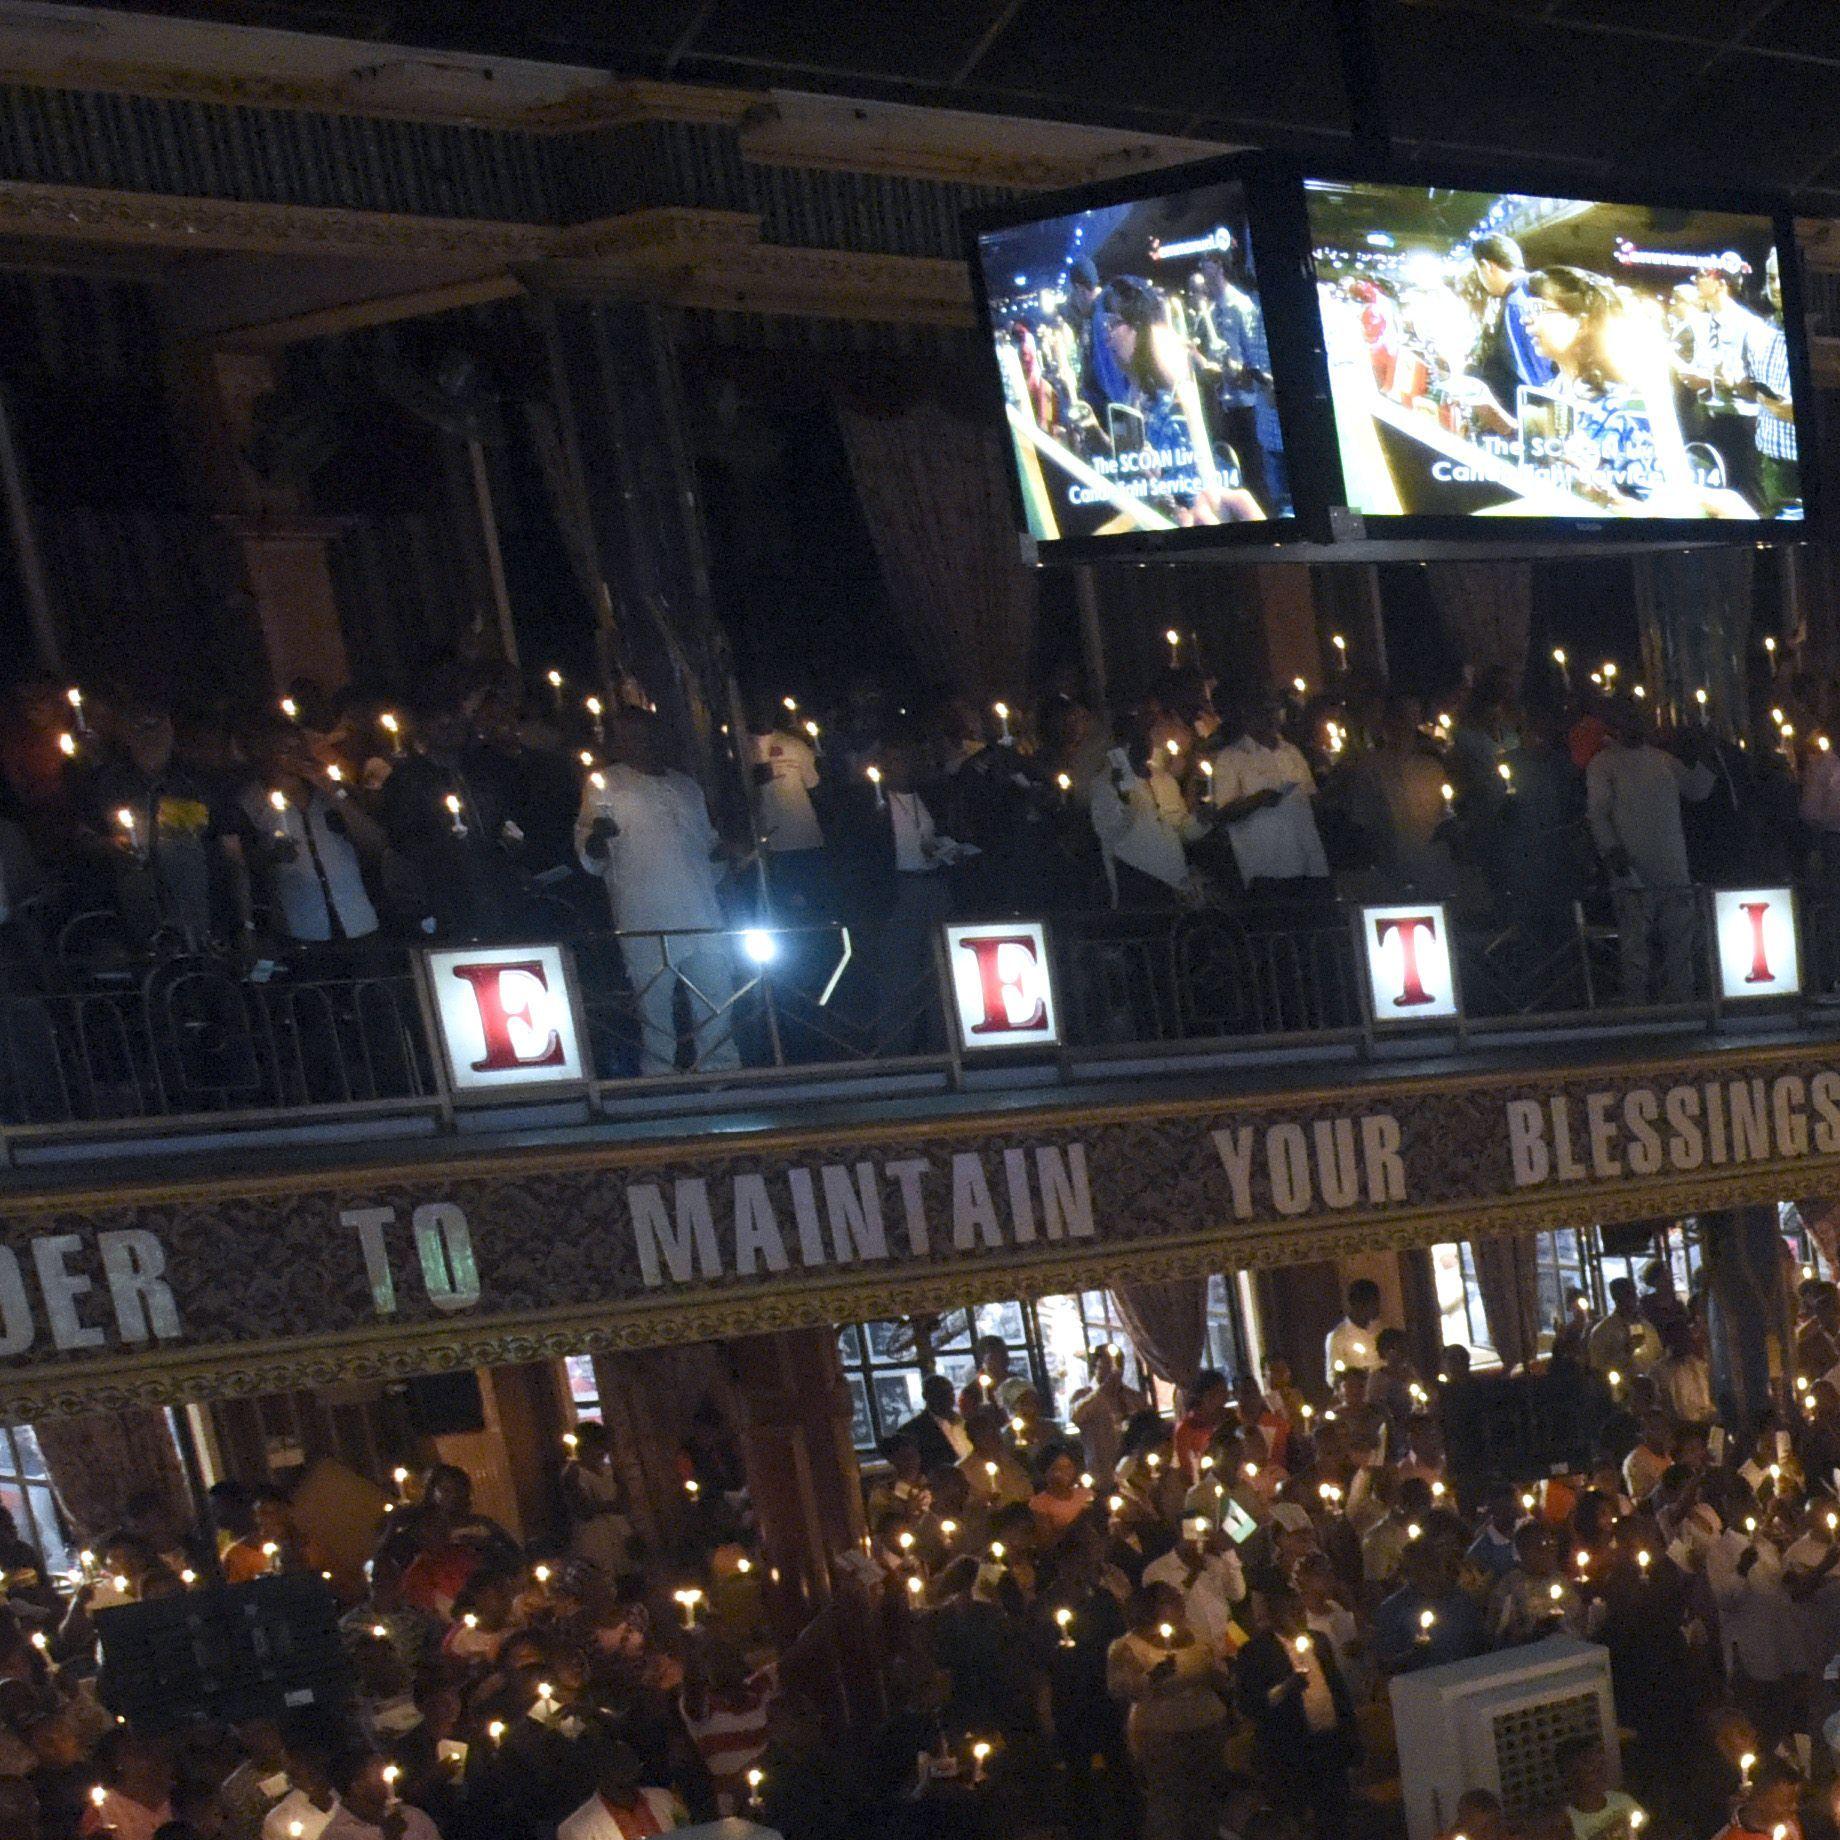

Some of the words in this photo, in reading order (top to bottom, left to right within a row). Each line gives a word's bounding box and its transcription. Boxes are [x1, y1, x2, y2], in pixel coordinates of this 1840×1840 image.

[1092, 456, 1118, 475] The
[1120, 449, 1173, 473] SCOAN
[340, 1202, 480, 1315] TO
[626, 1143, 1097, 1286] MAINTAIN
[1211, 1114, 1407, 1220] YOUR
